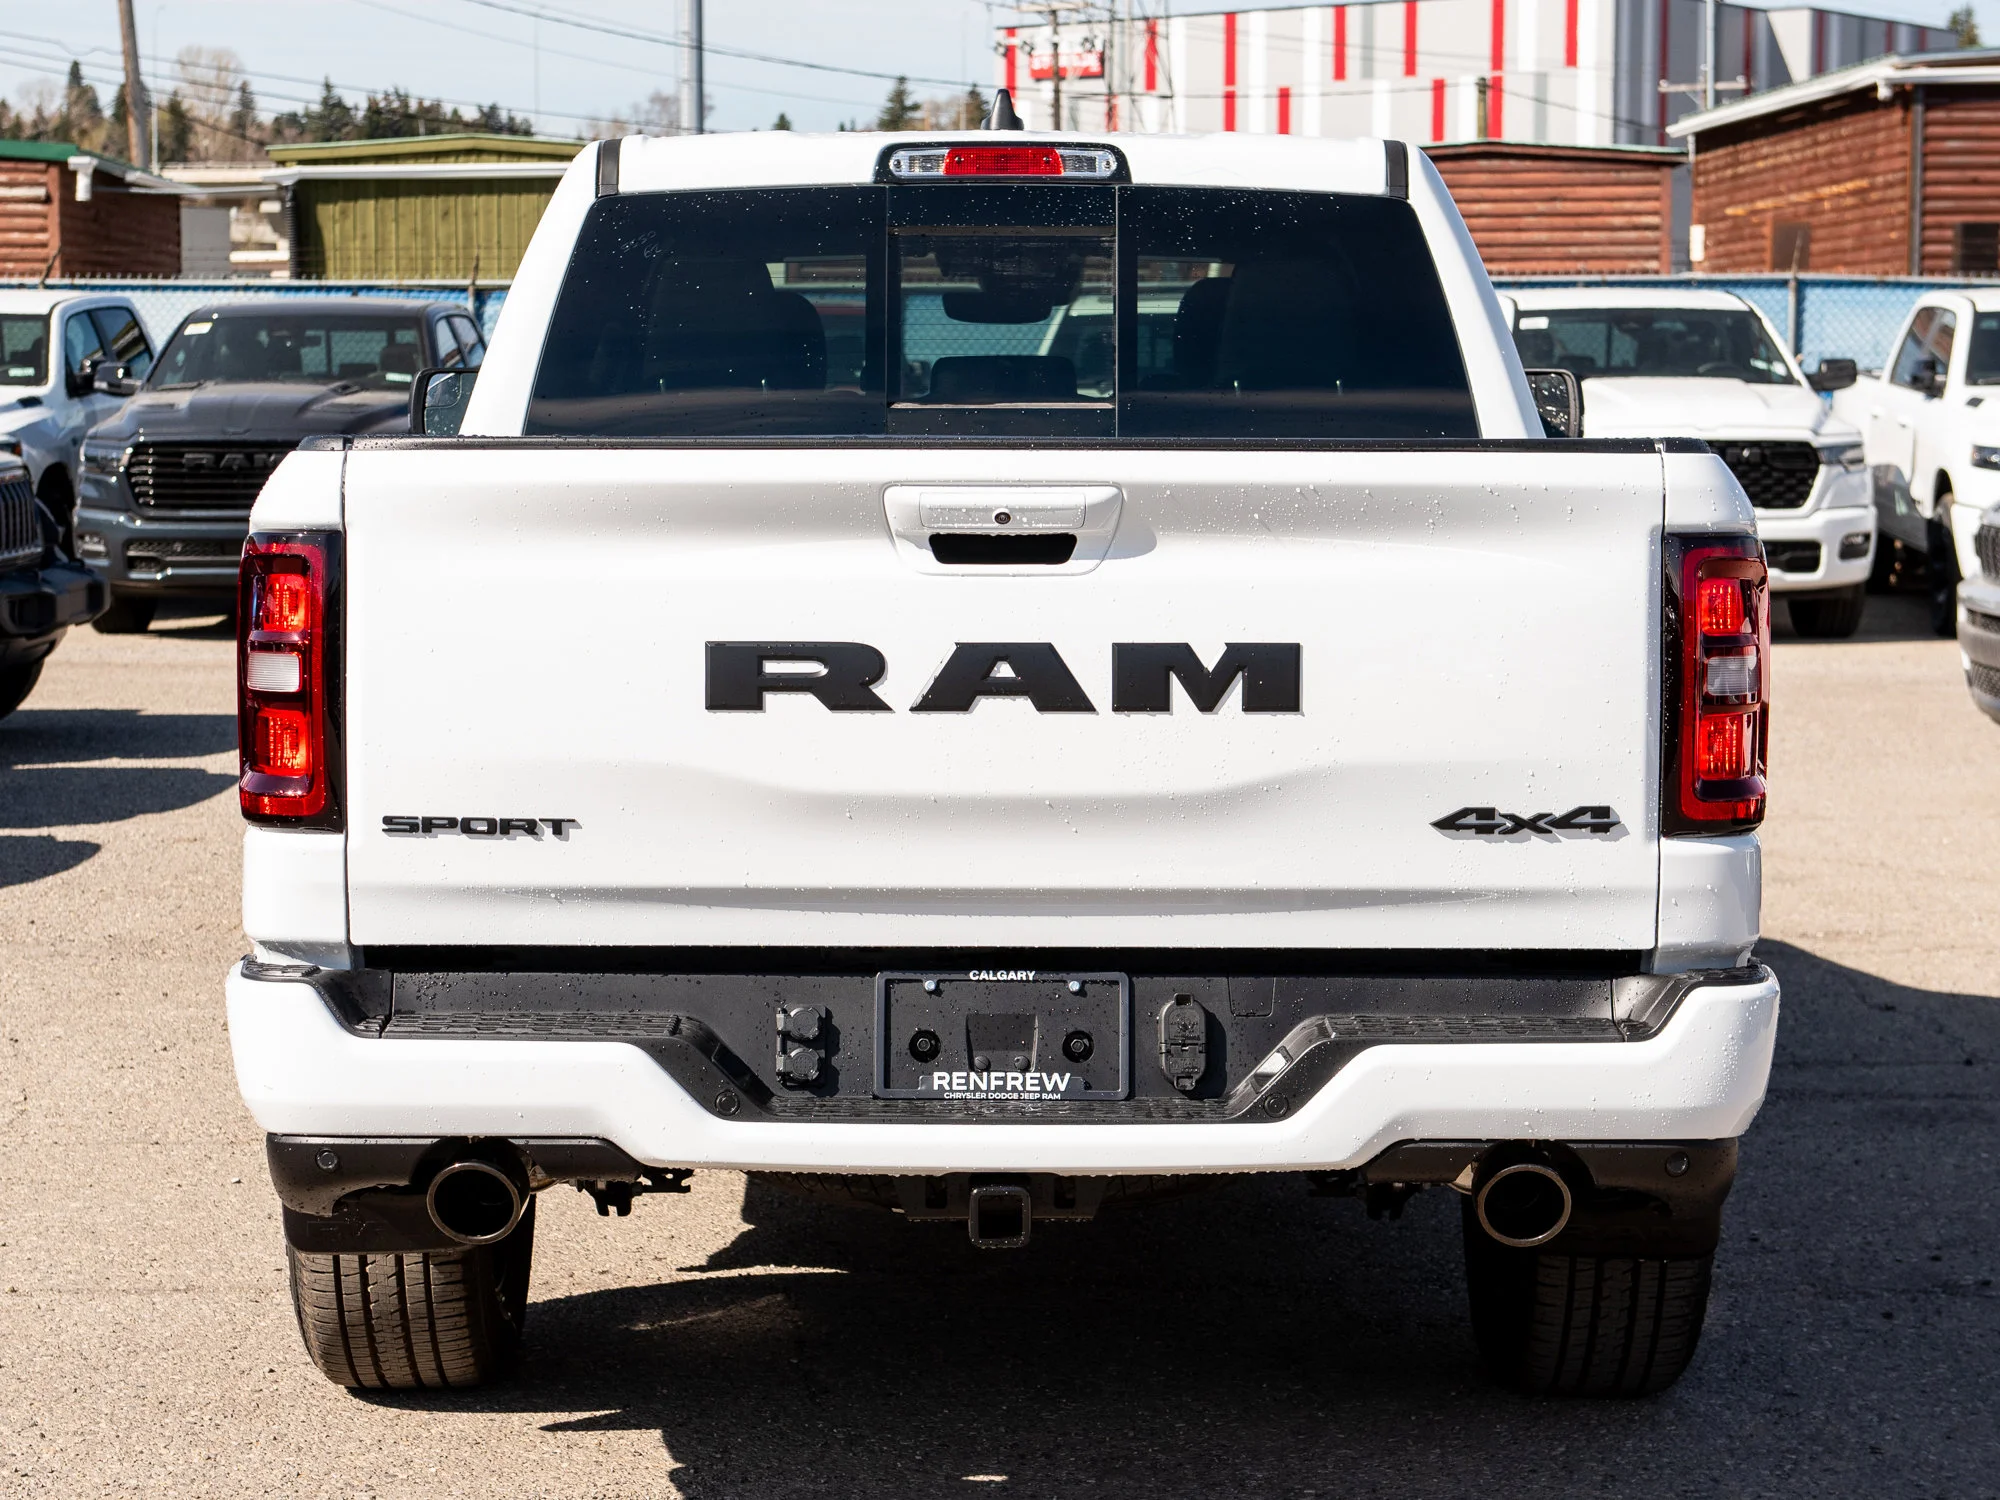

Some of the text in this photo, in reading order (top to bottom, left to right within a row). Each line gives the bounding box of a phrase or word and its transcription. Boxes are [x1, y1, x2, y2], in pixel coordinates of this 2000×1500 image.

[705, 641, 1302, 714] RAM
[382, 815, 576, 836] SPORT
[969, 970, 1036, 981] CALGARY
[933, 1071, 1071, 1092] RENFREW
[1019, 1092, 1040, 1100] JEEP
